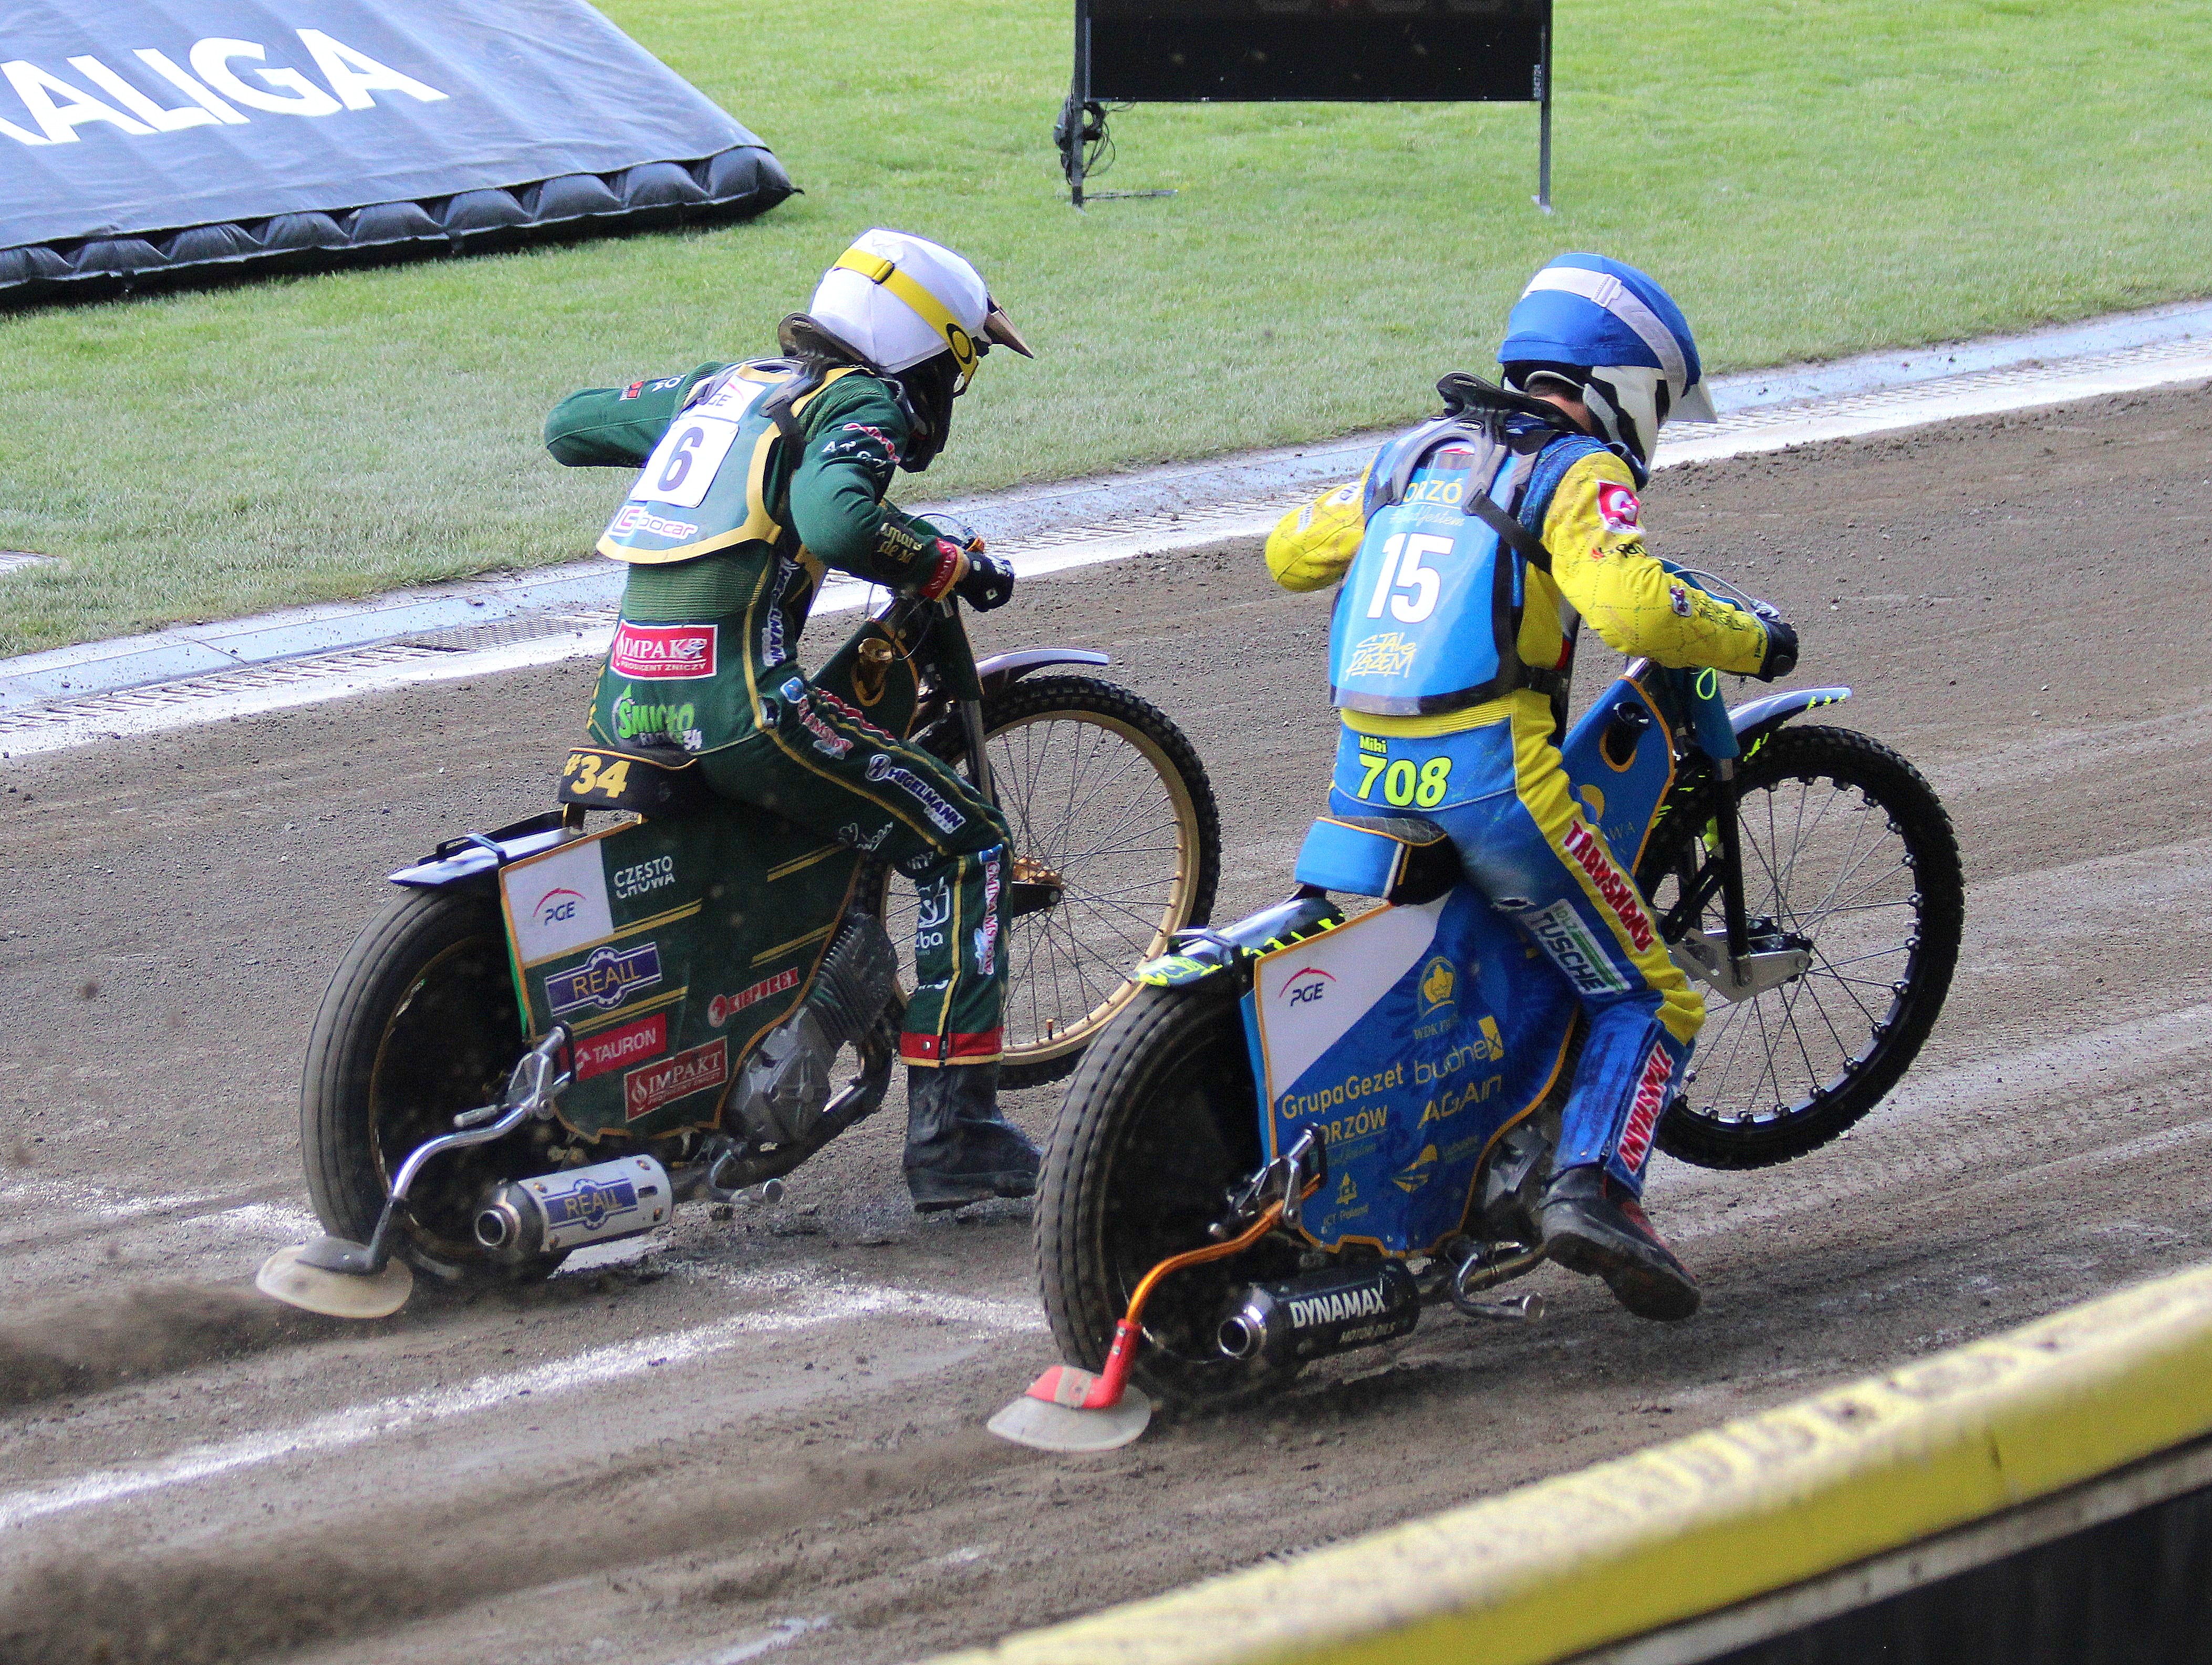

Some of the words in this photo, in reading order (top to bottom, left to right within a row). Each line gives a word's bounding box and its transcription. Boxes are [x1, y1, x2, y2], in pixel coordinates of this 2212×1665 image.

[658, 426, 704, 492] 6
[1367, 532, 1455, 624] 15
[623, 637, 707, 659] IMPAKT
[1359, 736, 1387, 754] Miki
[563, 753, 631, 799] #34
[1357, 753, 1452, 808] 708
[544, 901, 575, 926] PGE
[572, 960, 641, 999] REALL
[1290, 983, 1324, 1007] PGE
[592, 1028, 657, 1062] TAURON
[649, 1050, 721, 1094] IMPAKT
[1322, 1105, 1388, 1145] ORZÓW
[564, 1190, 623, 1220] REALL
[1289, 1278, 1387, 1329] DYNAMAX
